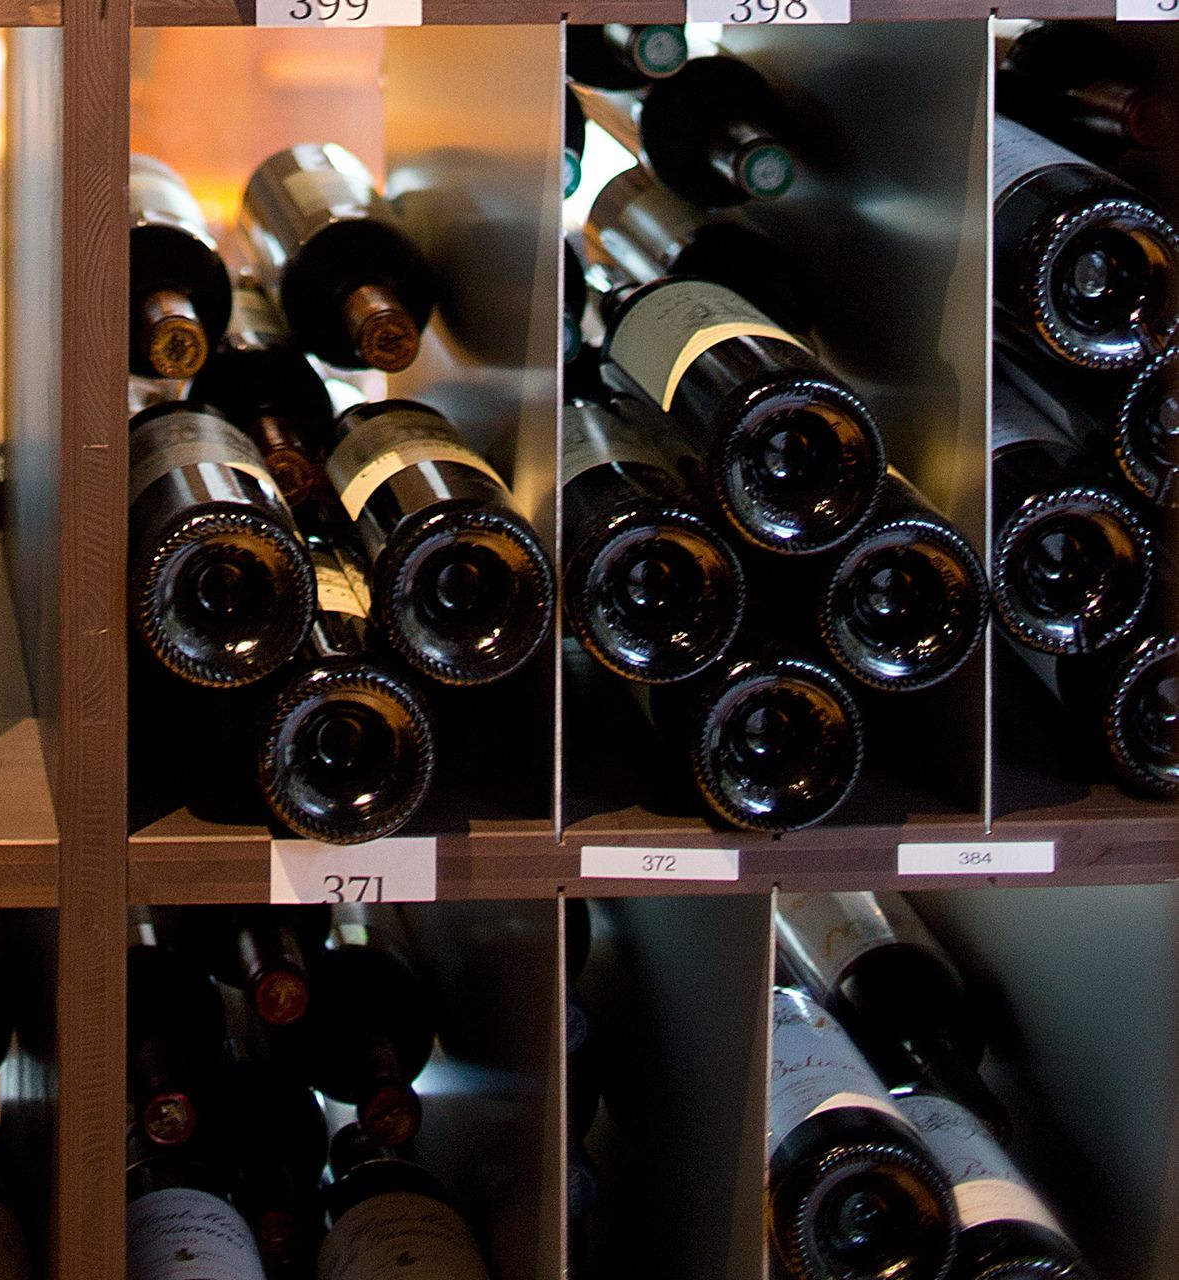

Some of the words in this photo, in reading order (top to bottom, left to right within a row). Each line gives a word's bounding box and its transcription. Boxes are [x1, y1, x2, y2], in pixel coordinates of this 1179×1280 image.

[641, 855, 677, 874] 372
[957, 851, 993, 867] 384
[319, 875, 385, 903] 371
